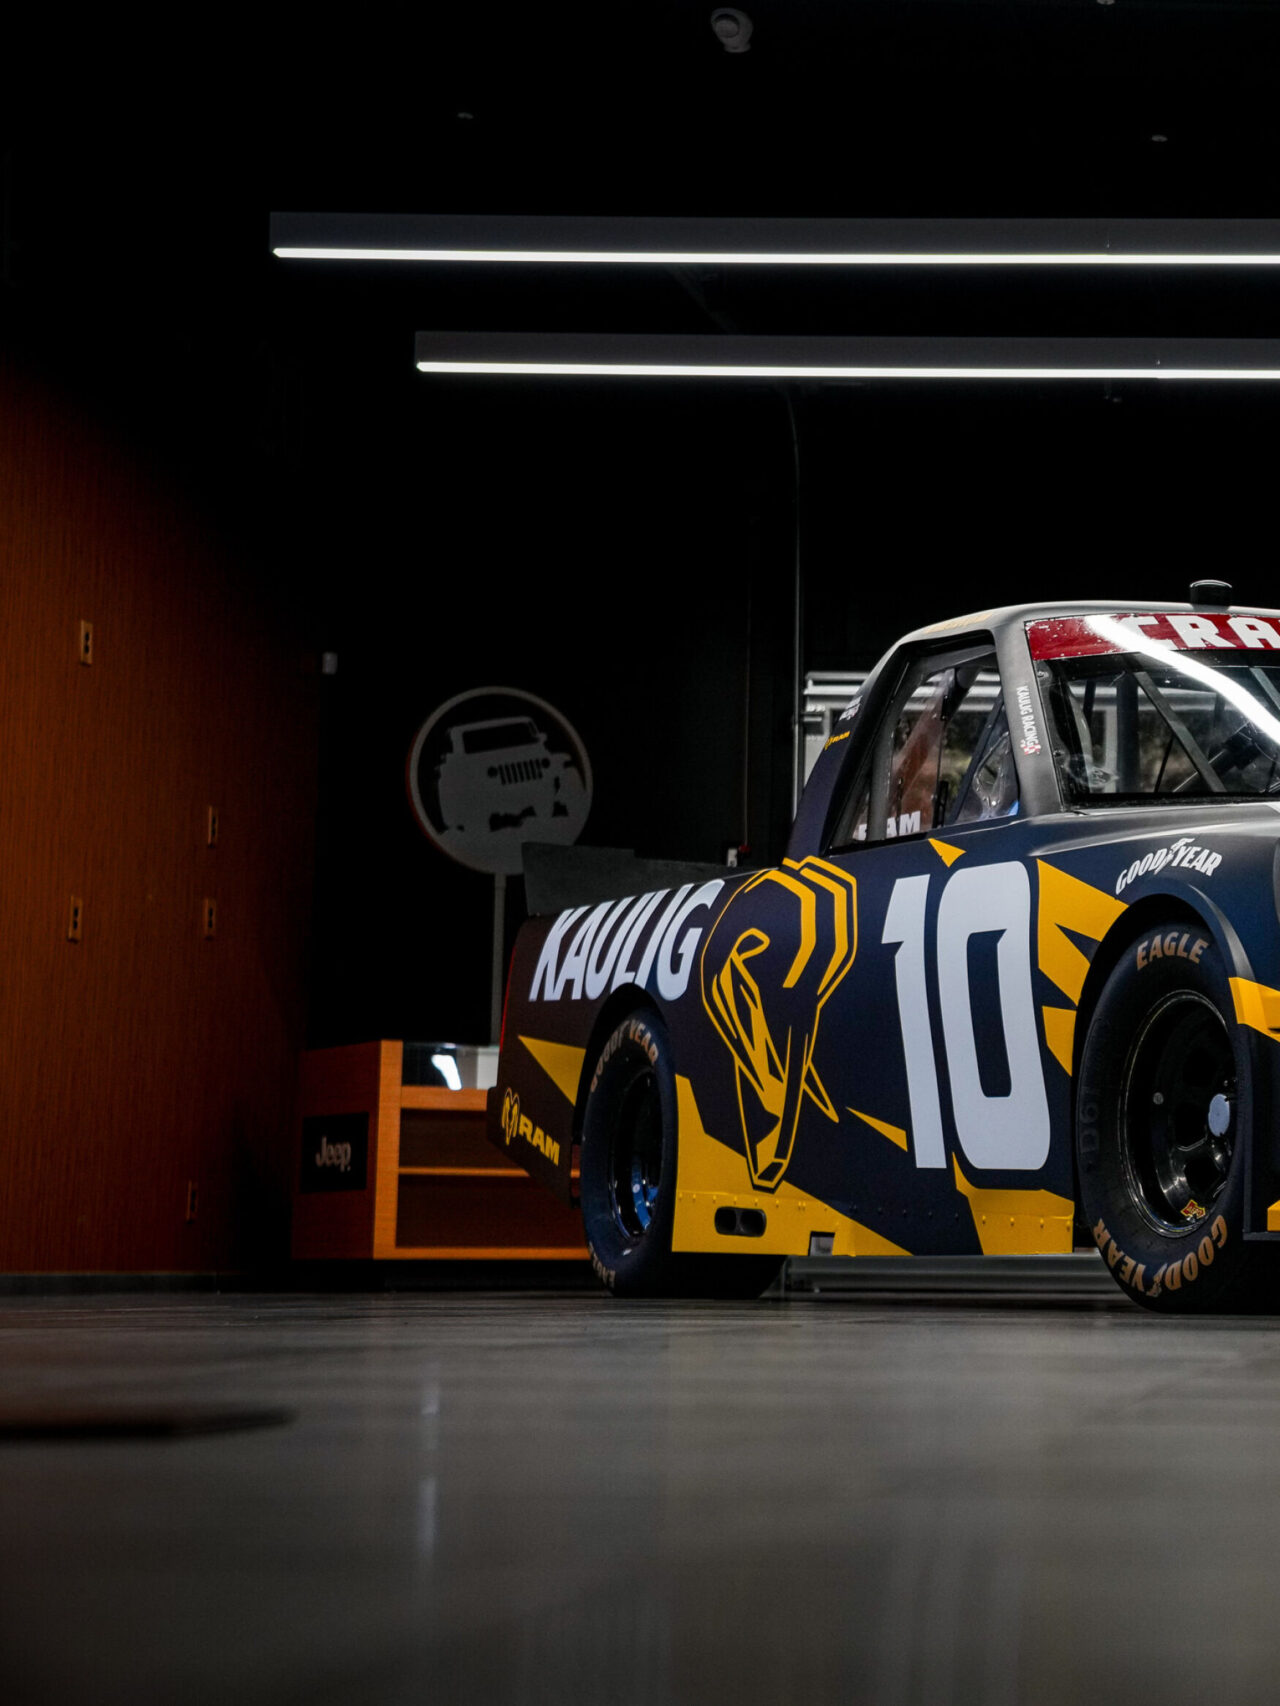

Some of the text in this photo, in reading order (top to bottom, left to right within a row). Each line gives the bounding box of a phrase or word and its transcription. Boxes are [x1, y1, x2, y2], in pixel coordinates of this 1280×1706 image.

[1016, 685, 1038, 747] KAULIG RACING
[1116, 838, 1222, 894] GOODYEAR
[529, 879, 726, 1001] KAULIG
[1137, 931, 1209, 971] EAGLE
[881, 861, 1051, 1170] 10
[315, 1136, 352, 1172] Jeep
[518, 1113, 560, 1166] RAM
[1093, 1214, 1228, 1298] GOODYEAR
